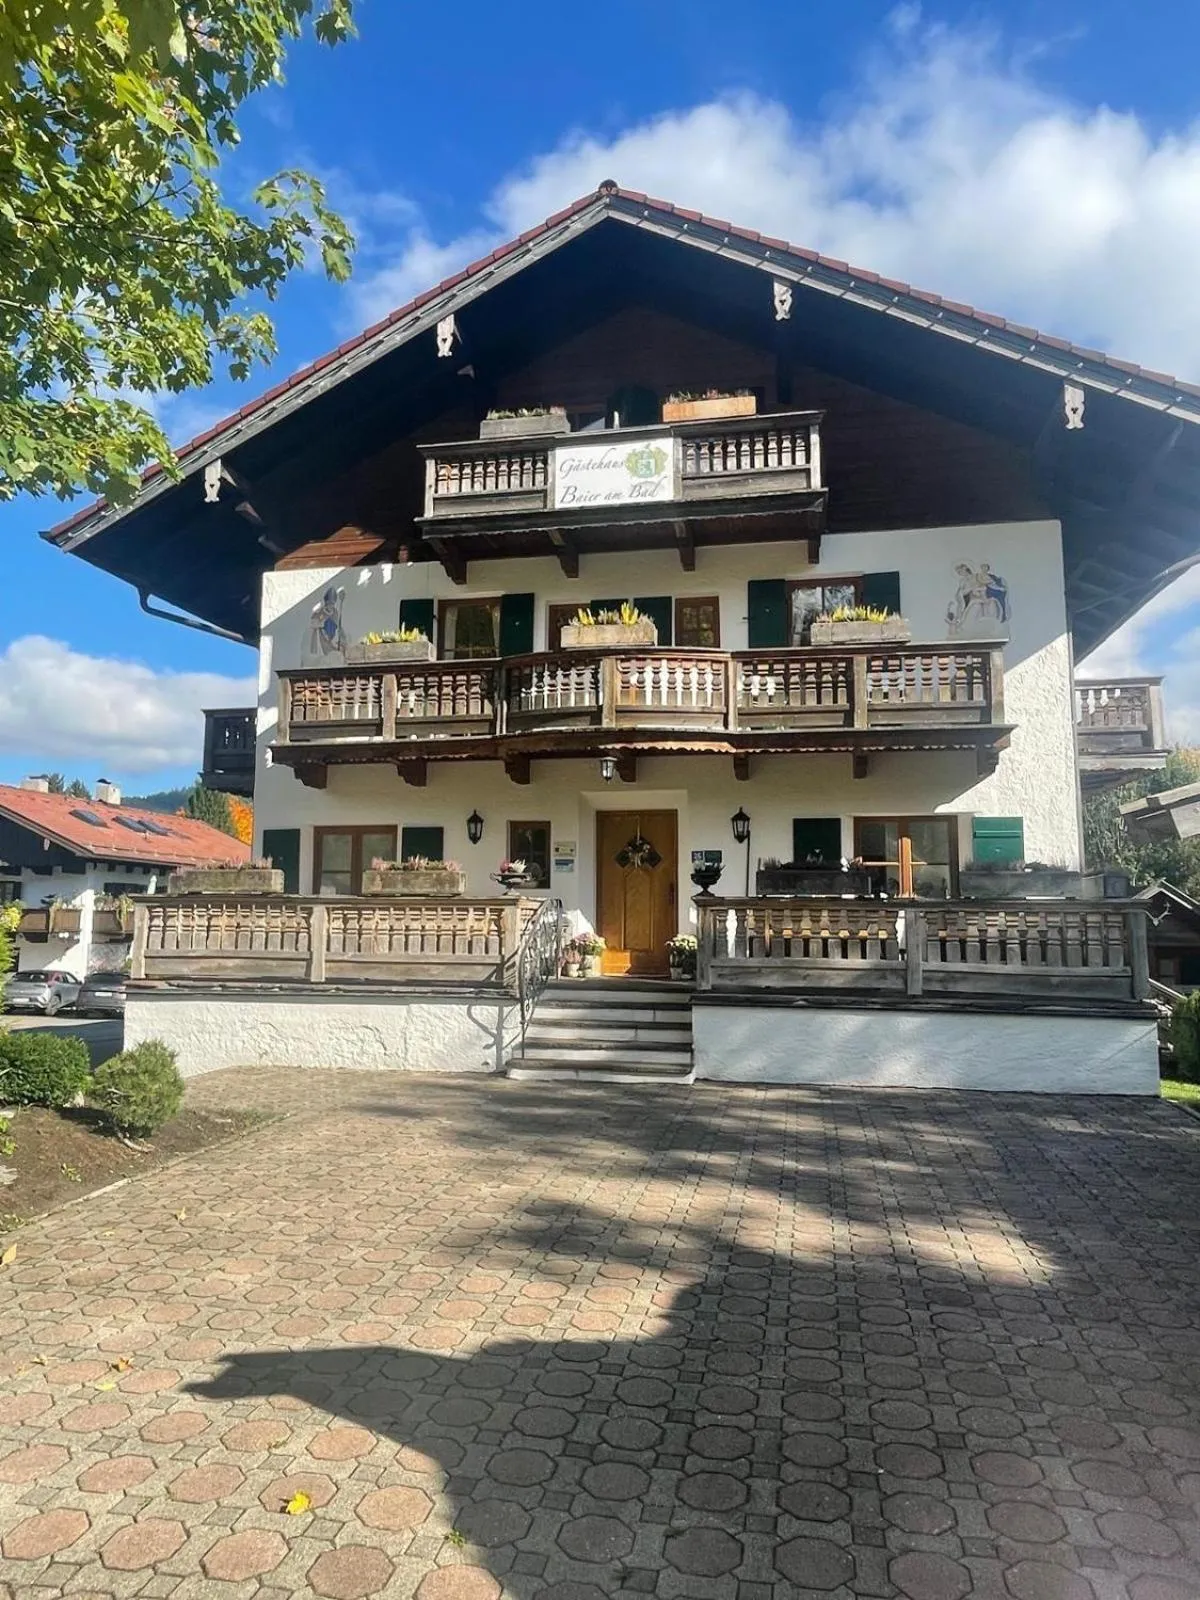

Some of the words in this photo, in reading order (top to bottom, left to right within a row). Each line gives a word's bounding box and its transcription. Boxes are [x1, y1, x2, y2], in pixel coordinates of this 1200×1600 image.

[560, 448, 625, 478] Gästehaus
[604, 491, 623, 500] am
[629, 476, 667, 498] Bad
